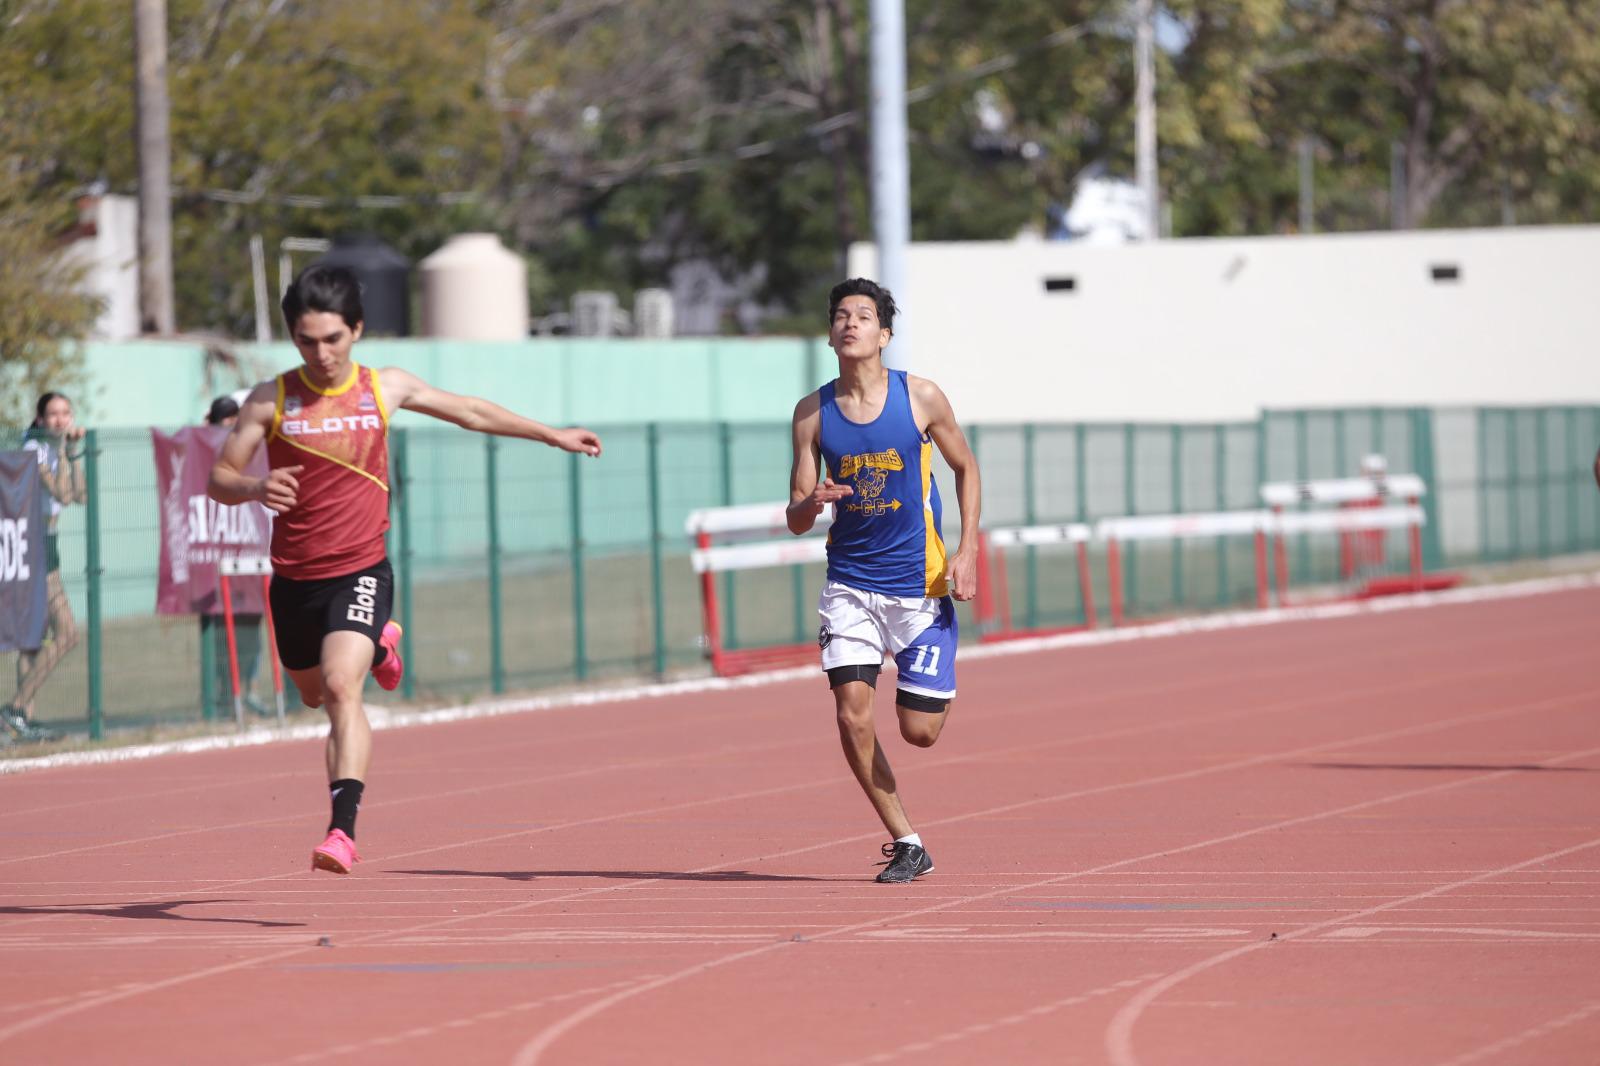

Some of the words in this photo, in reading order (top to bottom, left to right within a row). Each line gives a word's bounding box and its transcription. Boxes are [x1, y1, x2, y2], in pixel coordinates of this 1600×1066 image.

[282, 414, 380, 435] ELOTA
[0, 518, 30, 580] DE
[347, 576, 377, 626] Elota
[909, 645, 940, 676] 11
